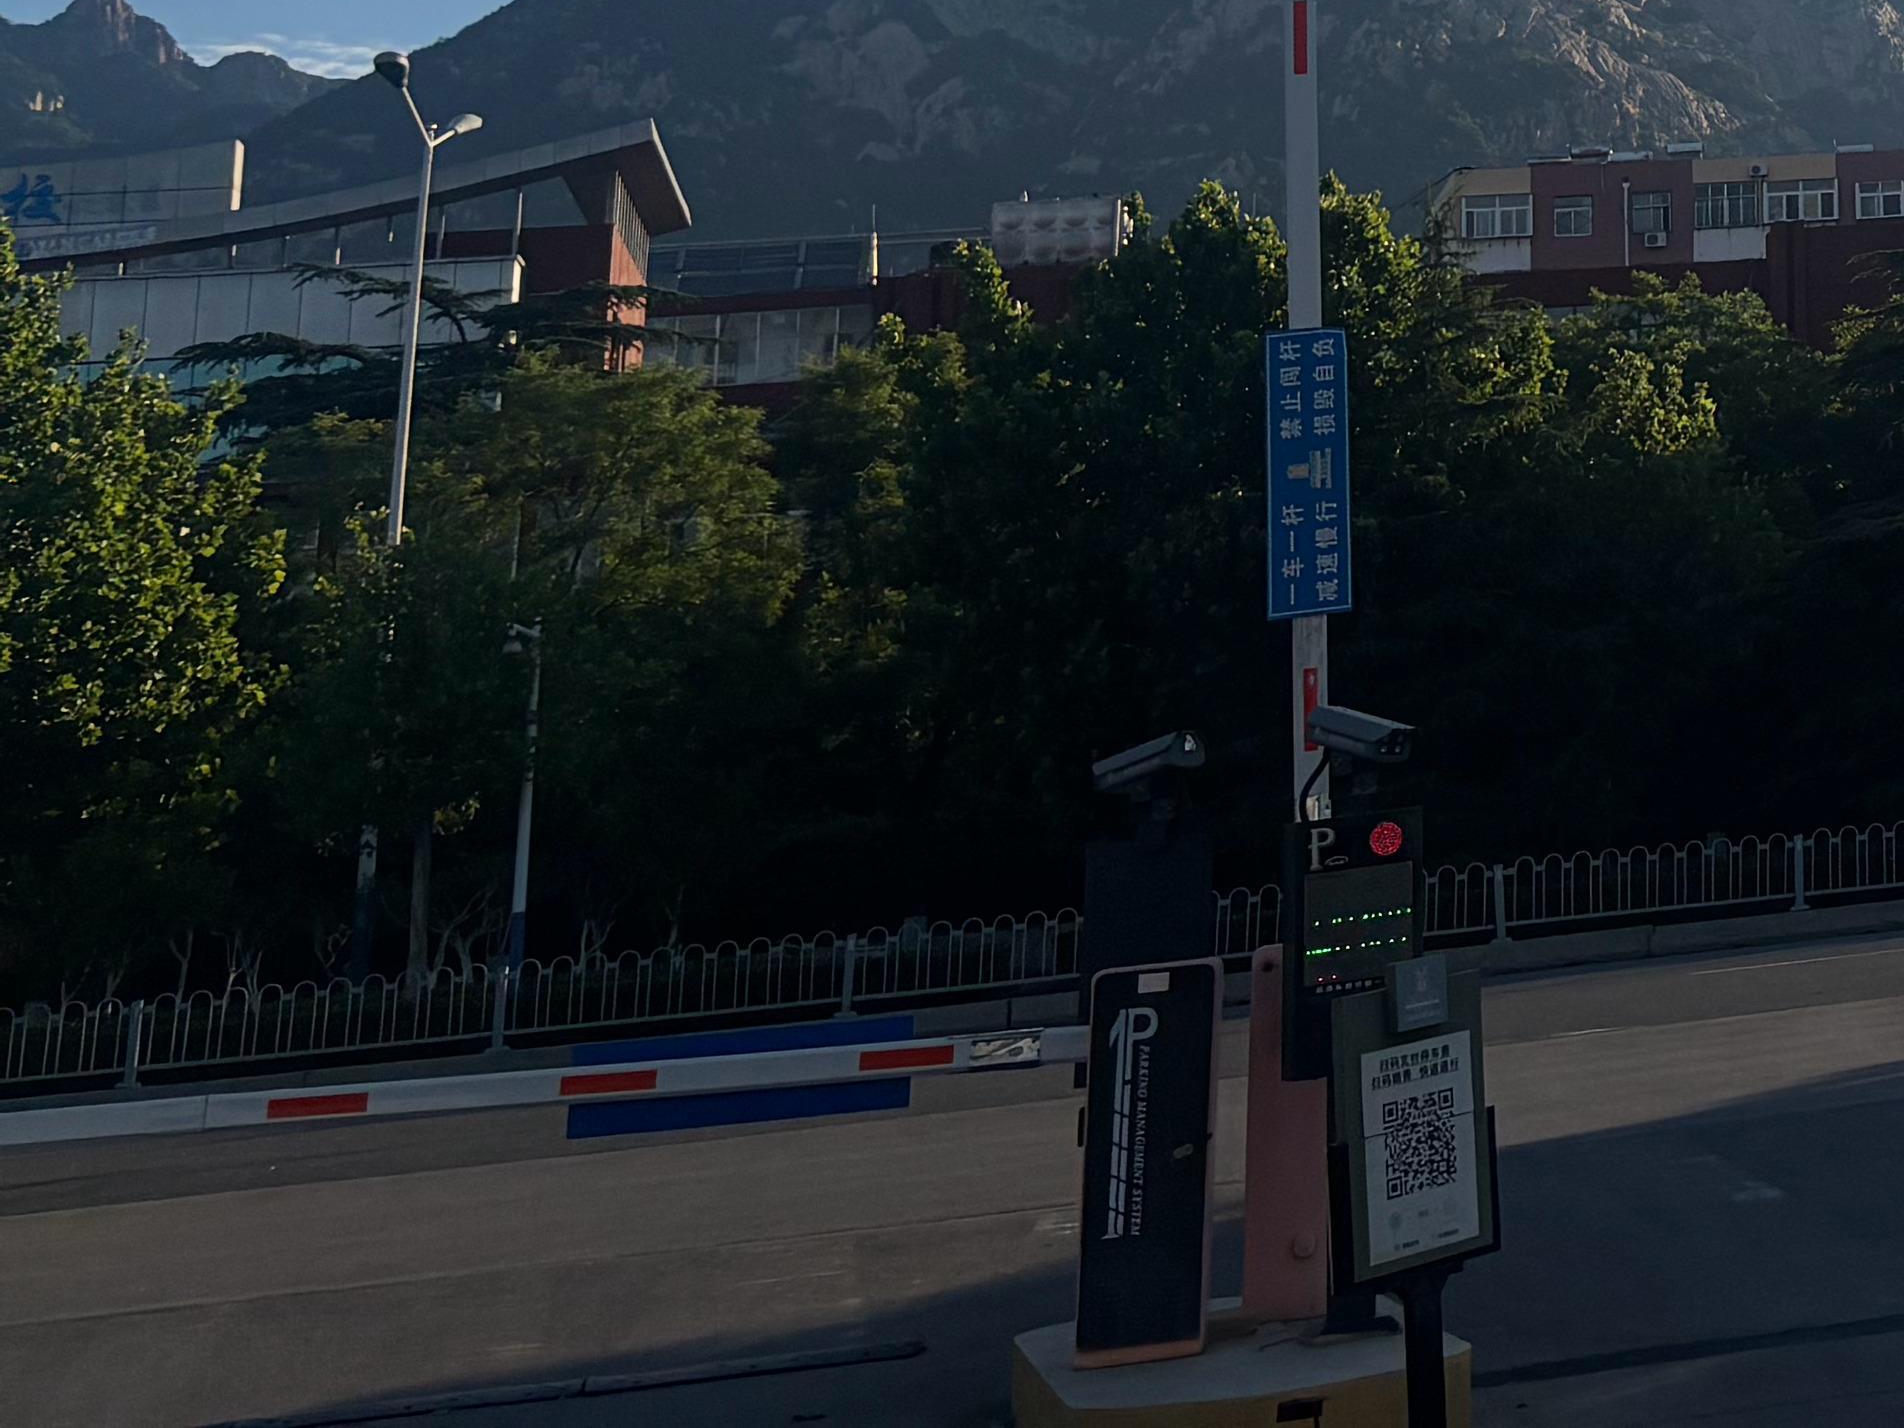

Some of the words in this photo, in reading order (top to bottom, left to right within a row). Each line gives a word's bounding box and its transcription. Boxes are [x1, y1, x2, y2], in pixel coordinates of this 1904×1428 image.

[1279, 339, 1303, 440] 禁止闯杆
[1312, 337, 1336, 437] 损毁自负
[1280, 503, 1304, 606] 一车一杆
[1313, 499, 1339, 602] 减速慢行
[1132, 1100, 1147, 1185] MANAGEMENT
[1129, 1188, 1143, 1236] SYSTEM
